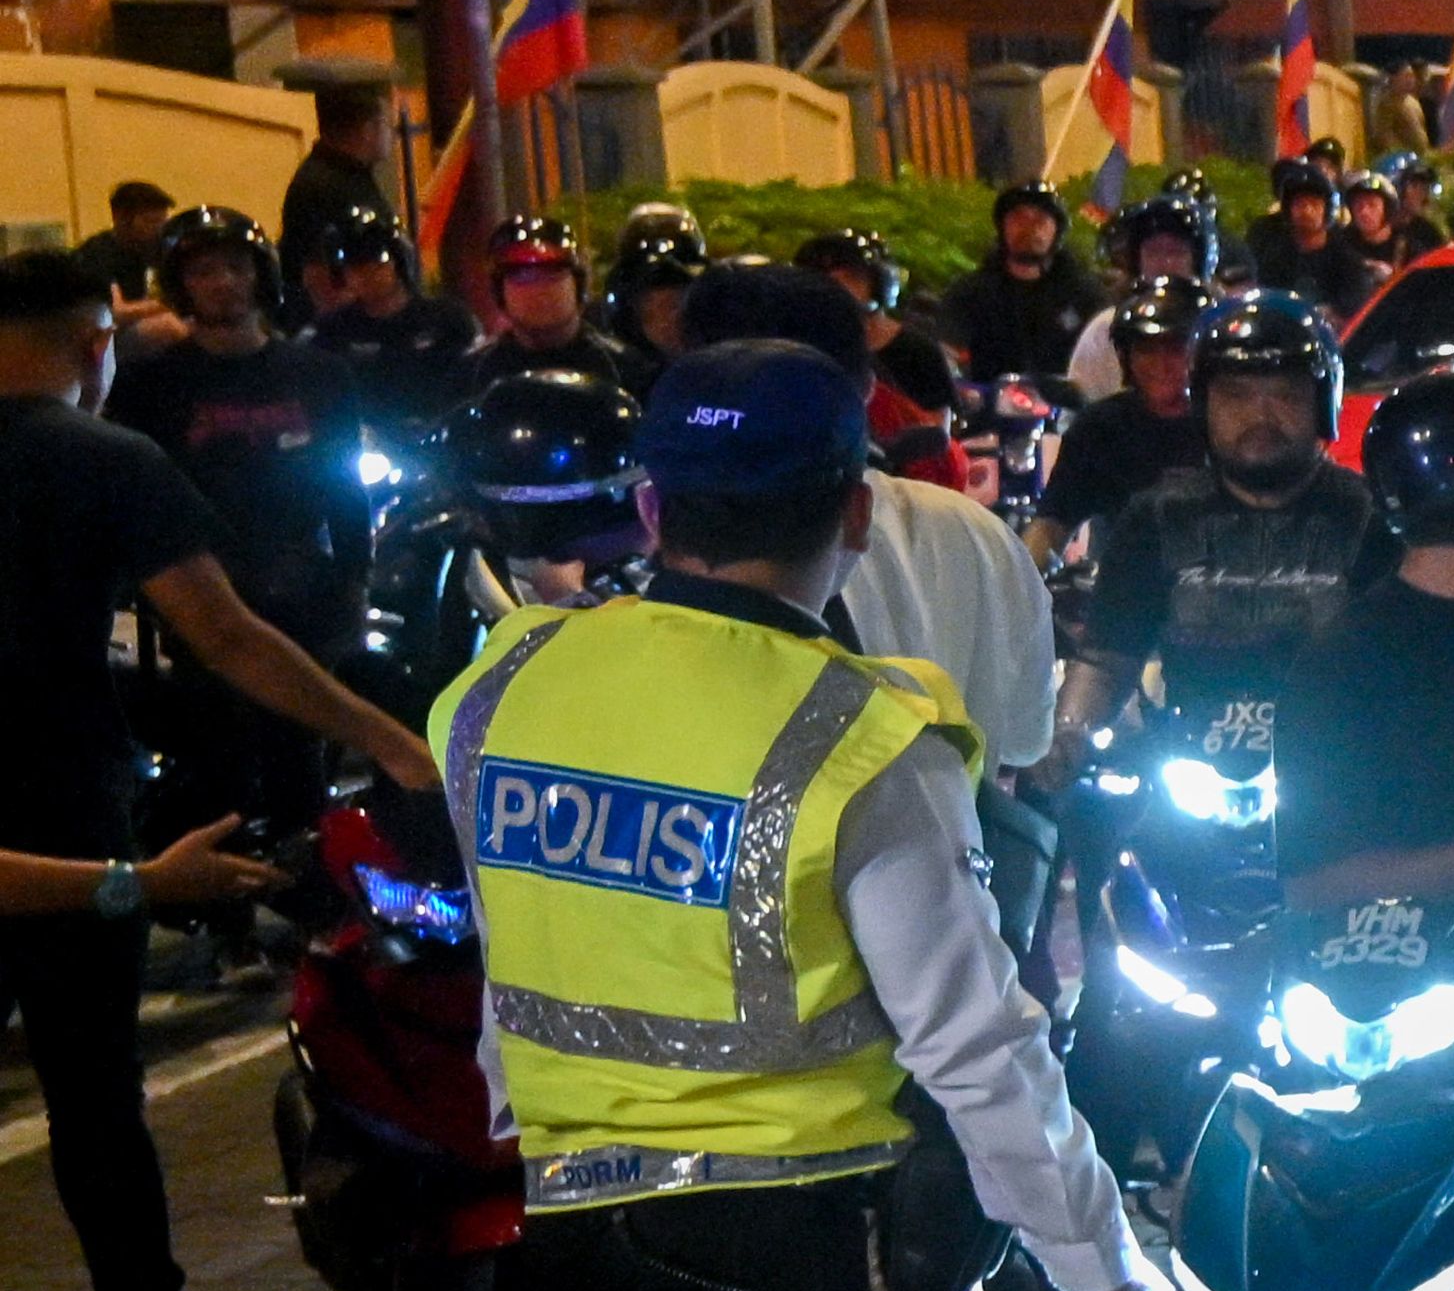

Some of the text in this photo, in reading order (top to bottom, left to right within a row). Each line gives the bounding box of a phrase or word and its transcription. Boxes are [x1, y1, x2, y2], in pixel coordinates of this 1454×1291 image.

[687, 406, 746, 430] JSPT
[491, 775, 707, 887] POLIS
[1346, 907, 1425, 936] VHM
[1320, 934, 1428, 969] 5329
[561, 1156, 642, 1189] PDRM
